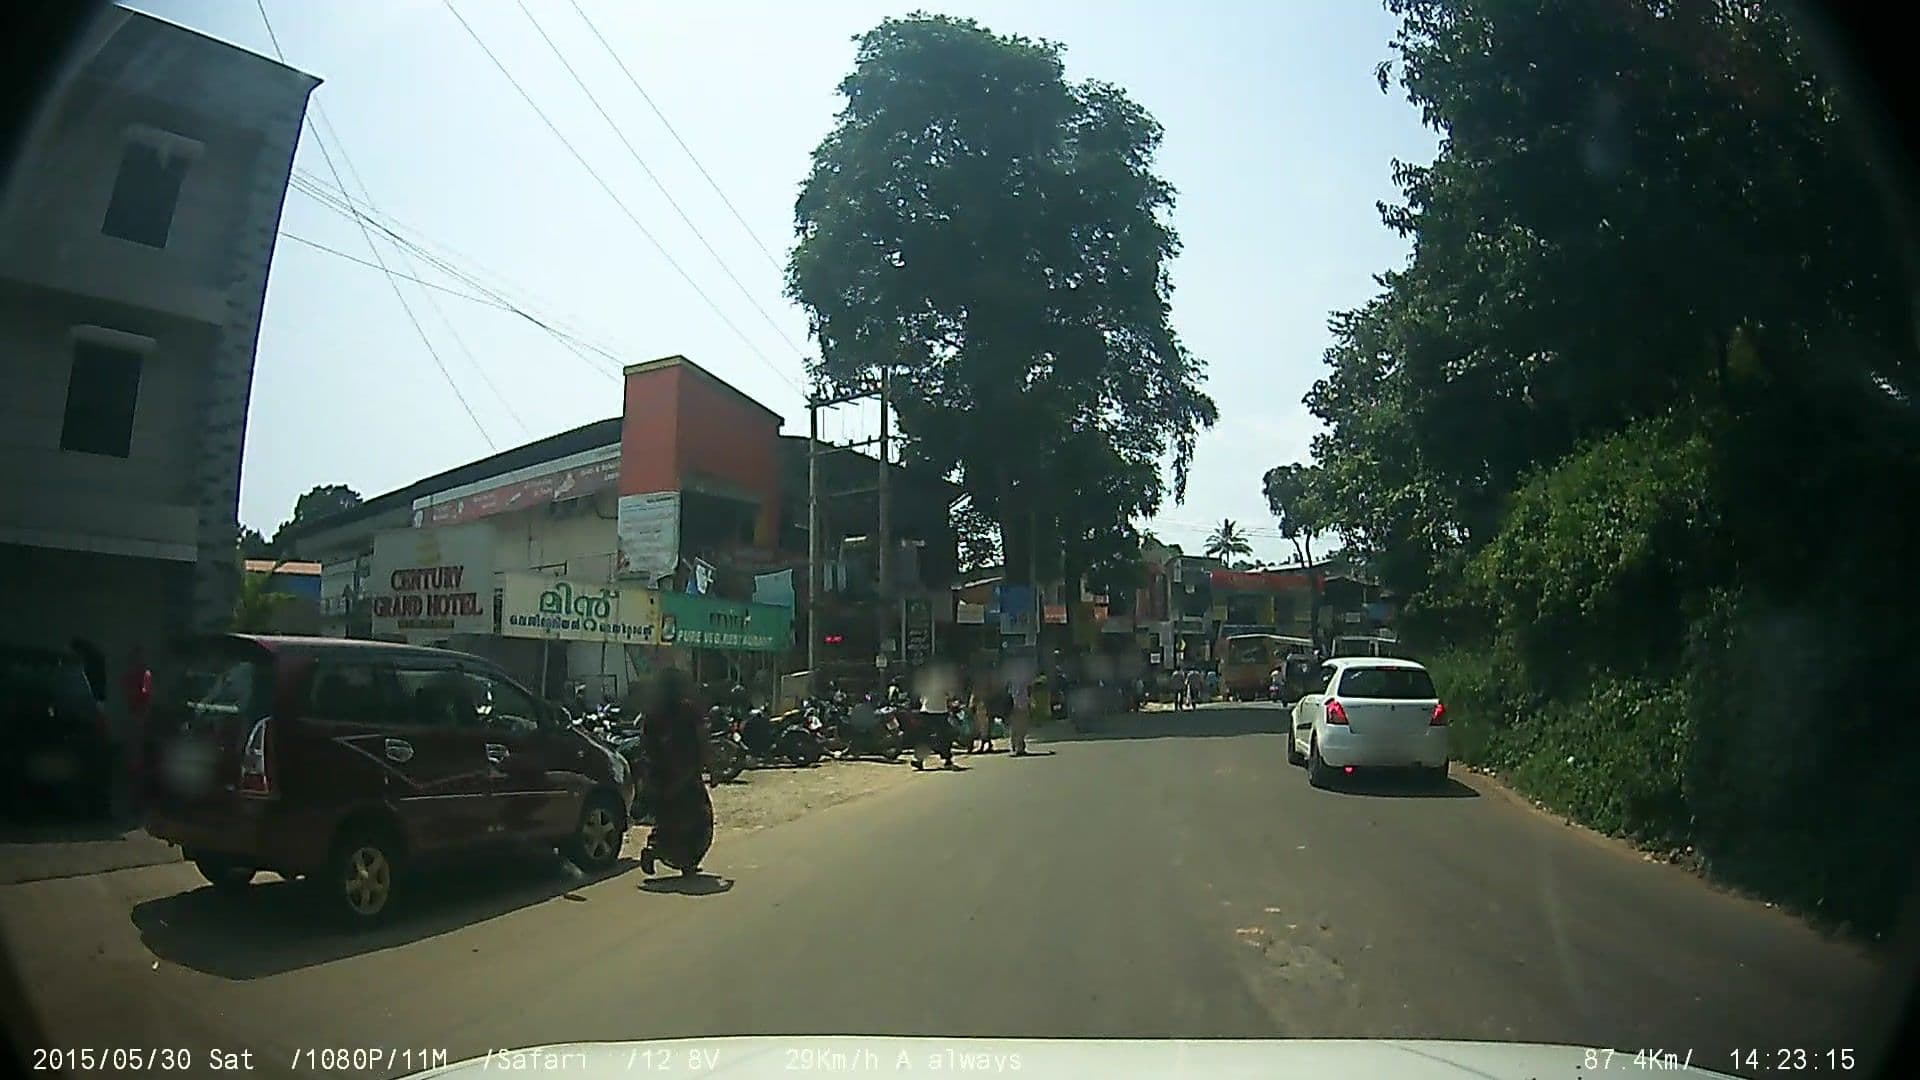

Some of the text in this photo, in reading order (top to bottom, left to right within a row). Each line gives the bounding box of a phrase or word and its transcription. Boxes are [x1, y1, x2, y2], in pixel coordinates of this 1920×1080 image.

[391, 565, 464, 591] CENTURY
[374, 592, 483, 617] GRAND HOTEL
